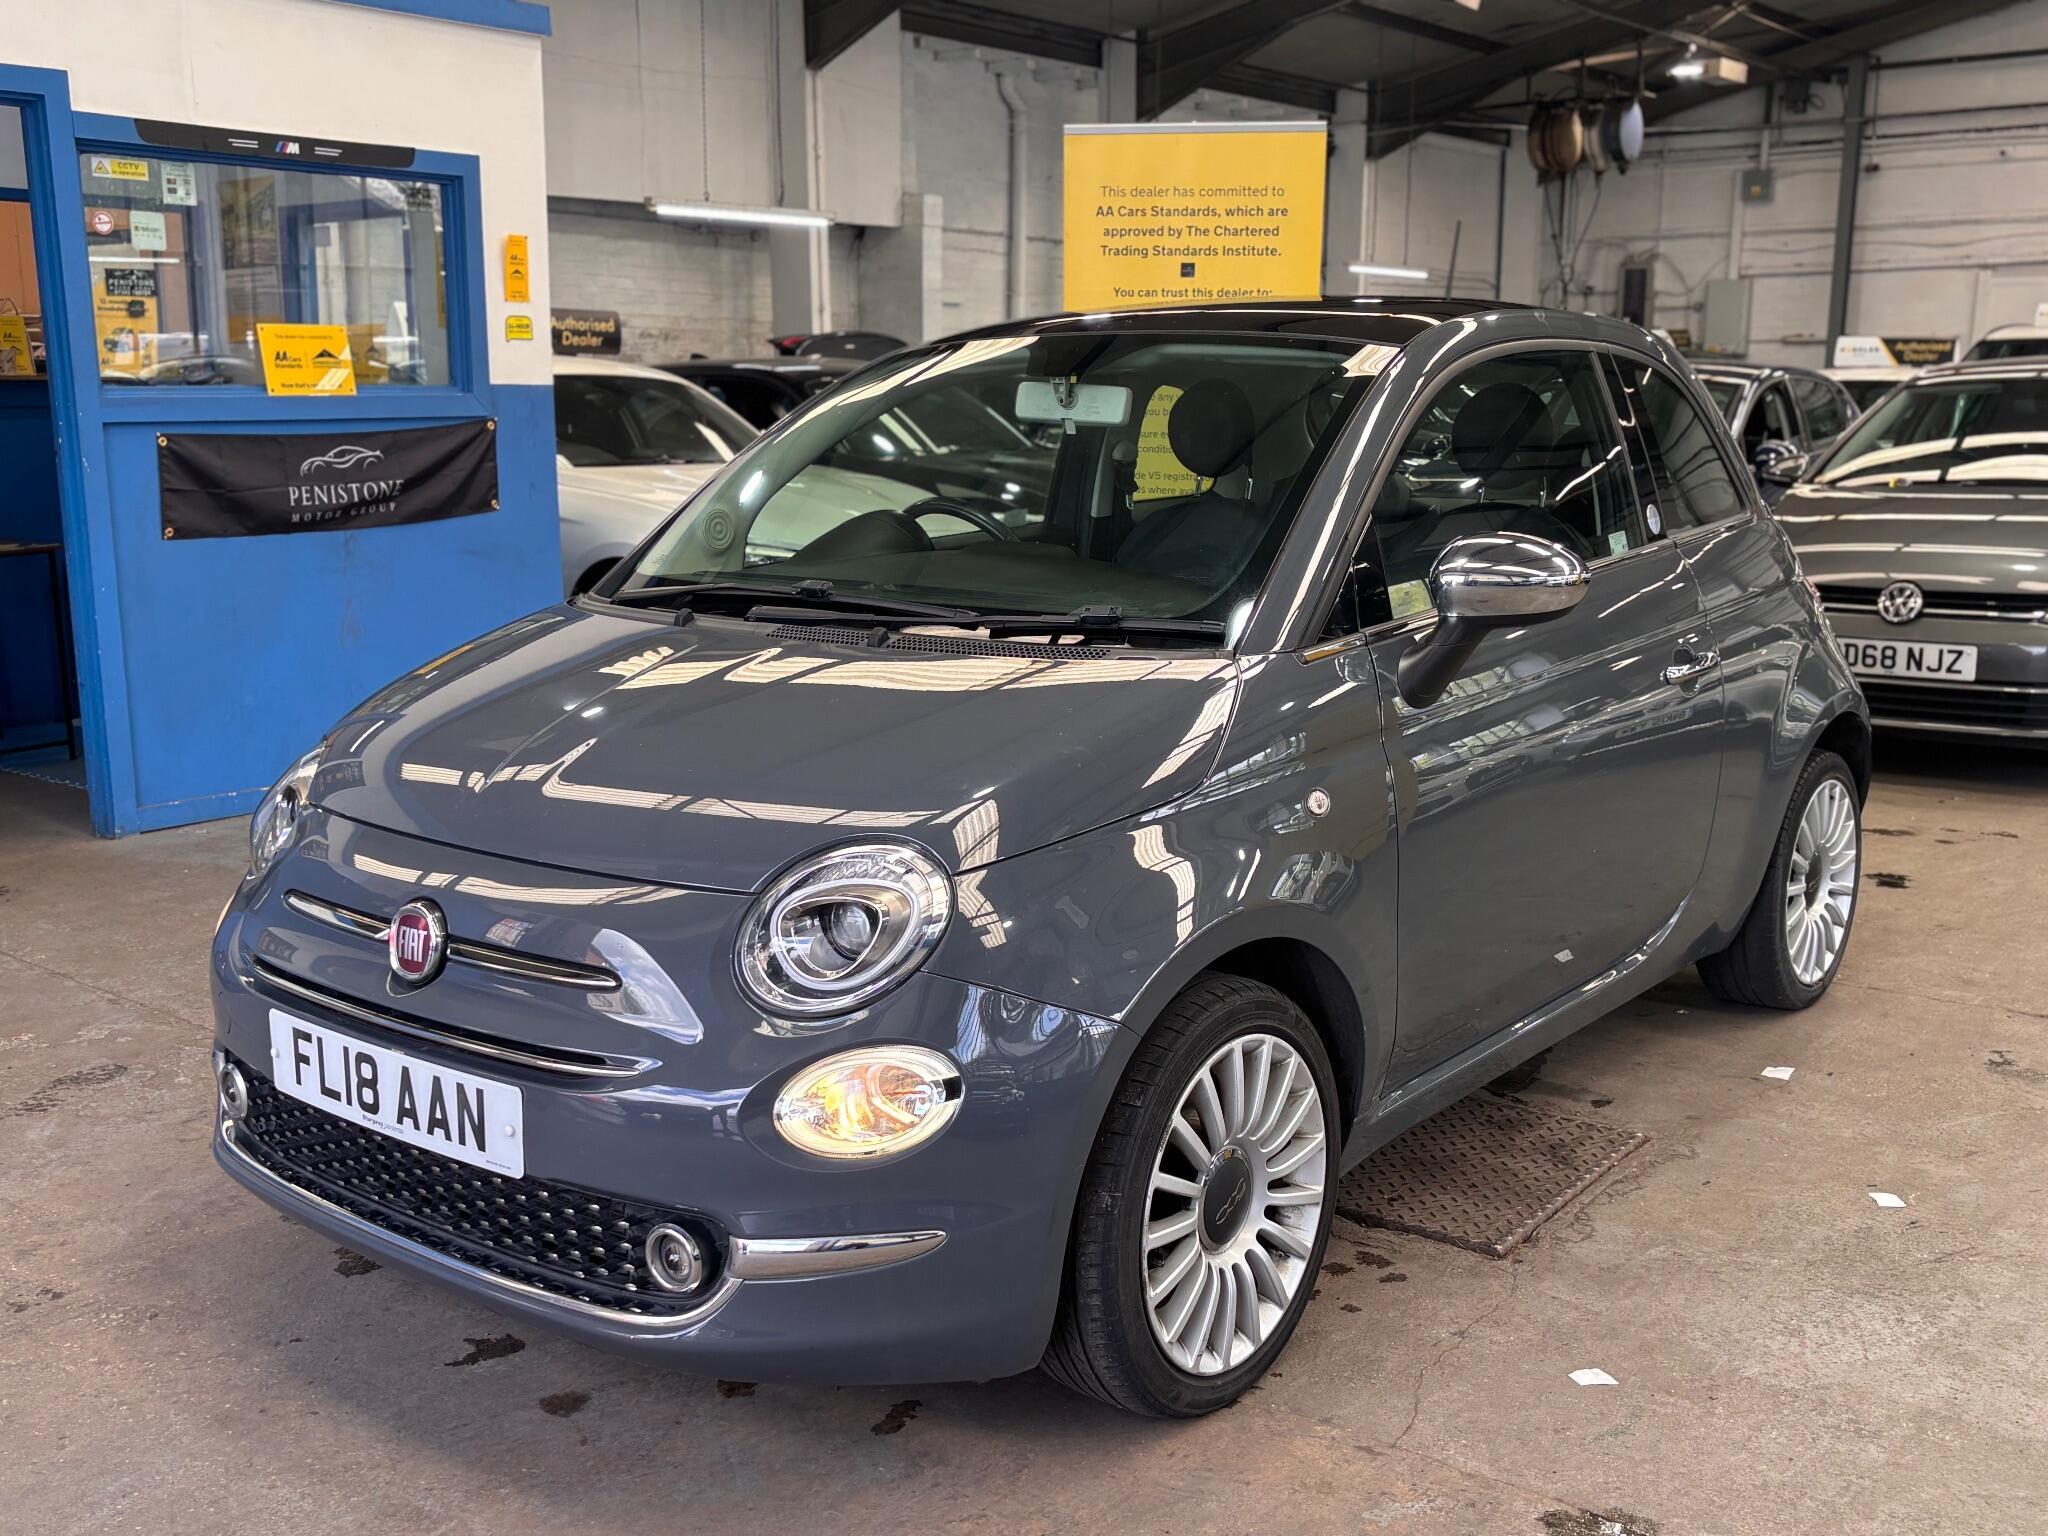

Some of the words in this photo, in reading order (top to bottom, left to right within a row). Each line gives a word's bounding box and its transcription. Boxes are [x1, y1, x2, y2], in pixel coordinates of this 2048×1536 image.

[117, 161, 140, 170] CCTV
[1101, 186, 1126, 198] This
[1130, 186, 1169, 198] dealer
[1173, 186, 1195, 198] has
[1199, 186, 1268, 198] committed
[1272, 186, 1285, 198] to
[1096, 206, 1114, 217] AA
[1118, 206, 1147, 217] Cars
[1150, 206, 1221, 219] Standards,
[1225, 206, 1264, 217] which
[1268, 208, 1288, 217] are
[1103, 226, 1164, 239] approved
[1168, 226, 1182, 239] by
[1186, 225, 1210, 237] The
[1214, 225, 1280, 237] Chartered
[1101, 245, 1148, 258] Trading
[1152, 245, 1219, 256] Standards
[1222, 245, 1281, 256] Institute.
[1113, 287, 1134, 298] You
[1138, 289, 1158, 298] can
[1161, 288, 1188, 298] trust
[1192, 287, 1213, 298] this
[1217, 287, 1254, 297] dealer
[551, 316, 616, 333] Authorised
[561, 331, 604, 346] Dealer
[275, 350, 288, 361] AA
[1148, 471, 1161, 480] V5
[288, 480, 404, 506] PENISTONE
[1148, 486, 1176, 495] where
[291, 511, 342, 523] MOTOR
[350, 502, 396, 516] GROUP
[1906, 647, 1964, 674] NJZ
[400, 925, 428, 963] FIAT
[292, 1026, 380, 1116] FL18
[396, 1065, 486, 1153] AAN
